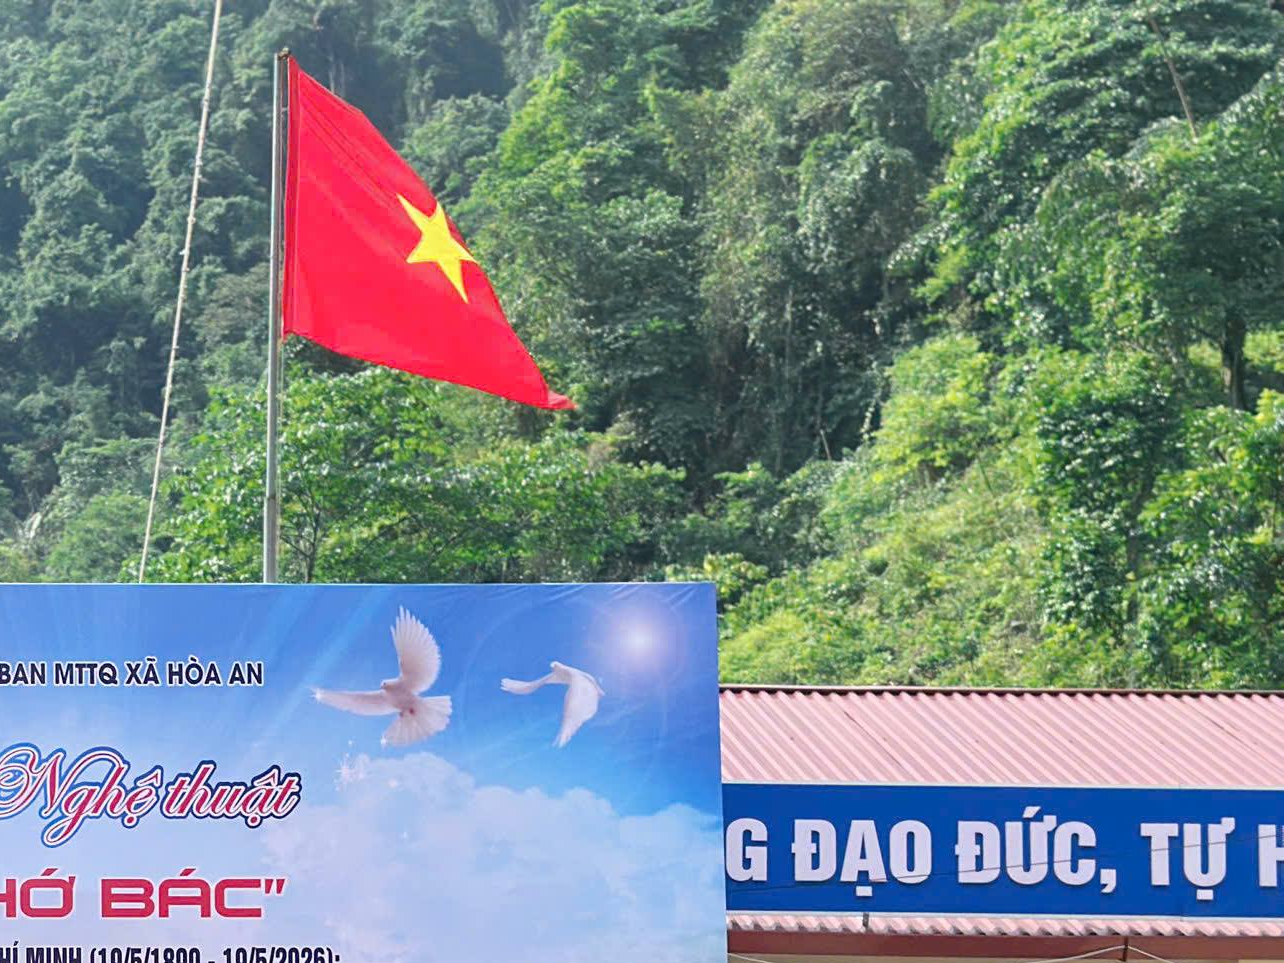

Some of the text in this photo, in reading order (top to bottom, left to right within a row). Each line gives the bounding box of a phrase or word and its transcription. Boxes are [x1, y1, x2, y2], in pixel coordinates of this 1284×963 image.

[54, 662, 118, 686] MTTQ
[124, 657, 160, 686] XÃ
[167, 656, 222, 686] HÒA
[228, 662, 264, 686] AN
[161, 759, 302, 829] thuật
[791, 818, 932, 897] ĐẠO
[955, 806, 1117, 893] ĐỨC,
[1140, 817, 1235, 901] TỰ
